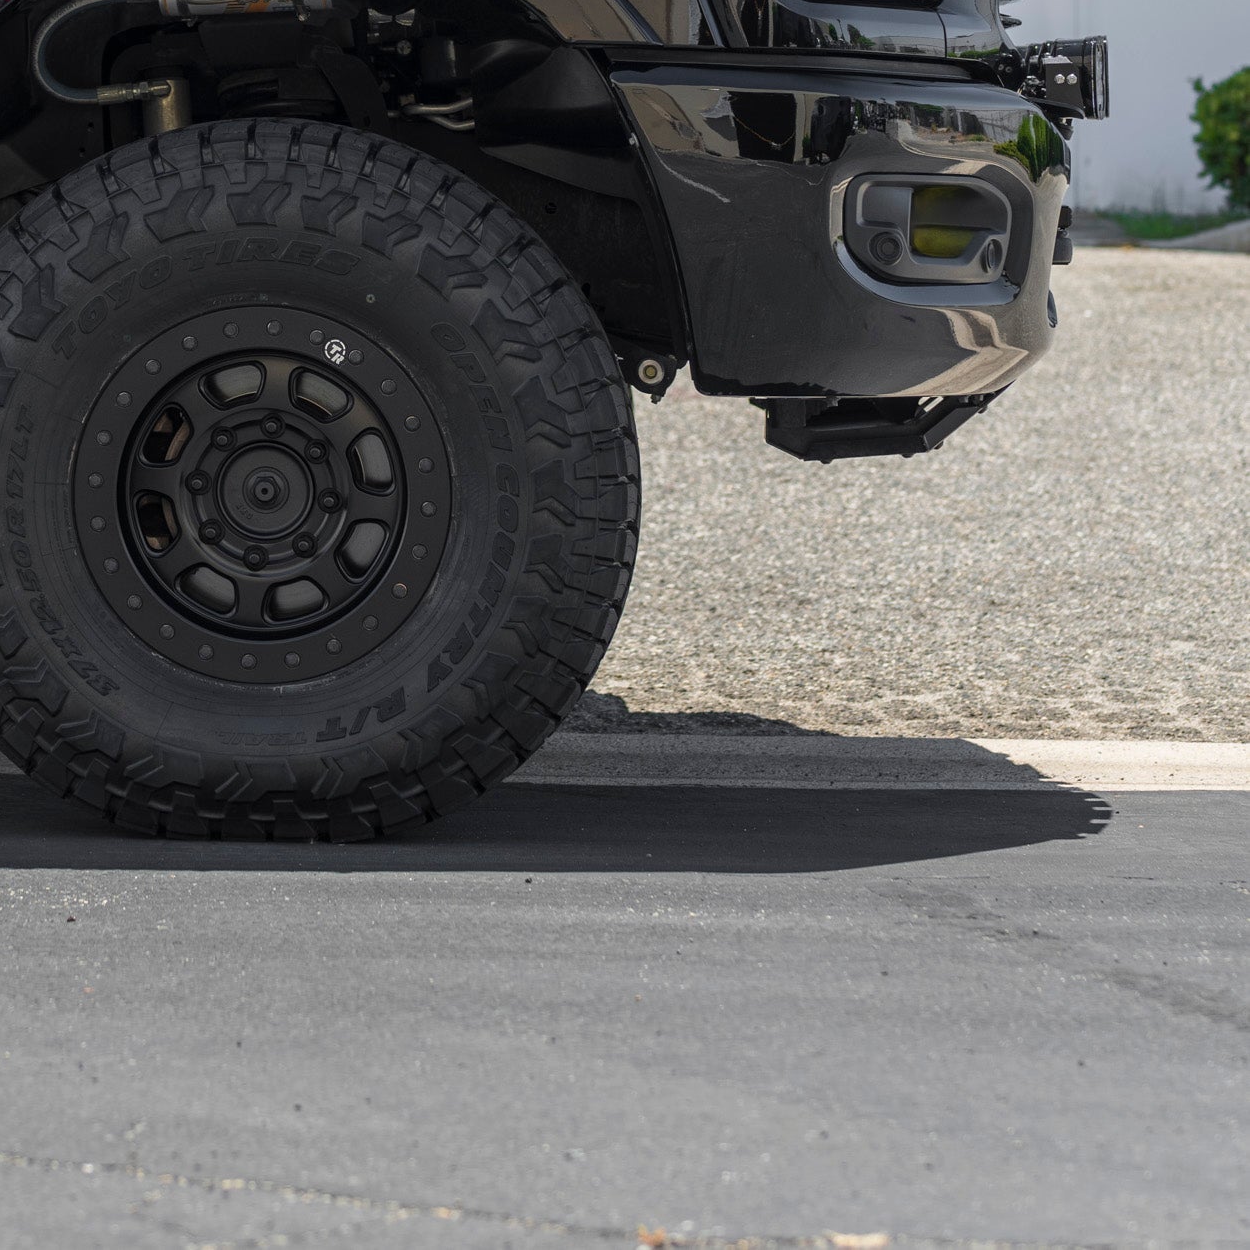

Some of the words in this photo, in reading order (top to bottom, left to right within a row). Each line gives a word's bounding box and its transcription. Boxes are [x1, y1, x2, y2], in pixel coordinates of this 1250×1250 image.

[51, 254, 173, 360] TOYO
[182, 236, 361, 276] TIRES
[429, 322, 513, 451] OPEN
[427, 463, 520, 692] COUNTRY
[316, 686, 406, 742] R/T
